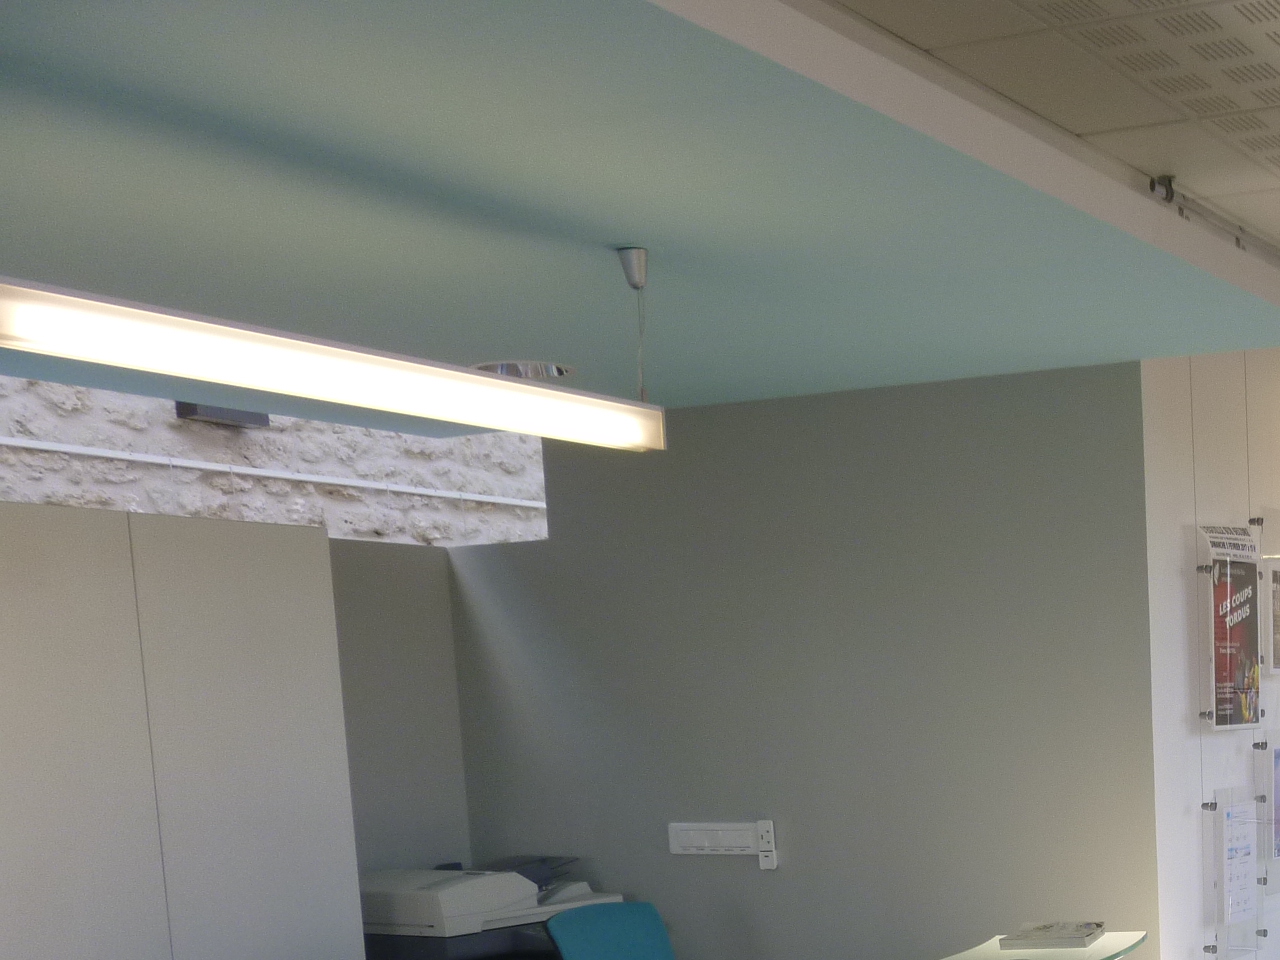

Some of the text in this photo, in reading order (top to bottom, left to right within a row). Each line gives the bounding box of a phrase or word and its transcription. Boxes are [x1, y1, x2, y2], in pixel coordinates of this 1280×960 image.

[1219, 586, 1252, 616] LES COUPS
[1225, 604, 1250, 629] TORDUS
